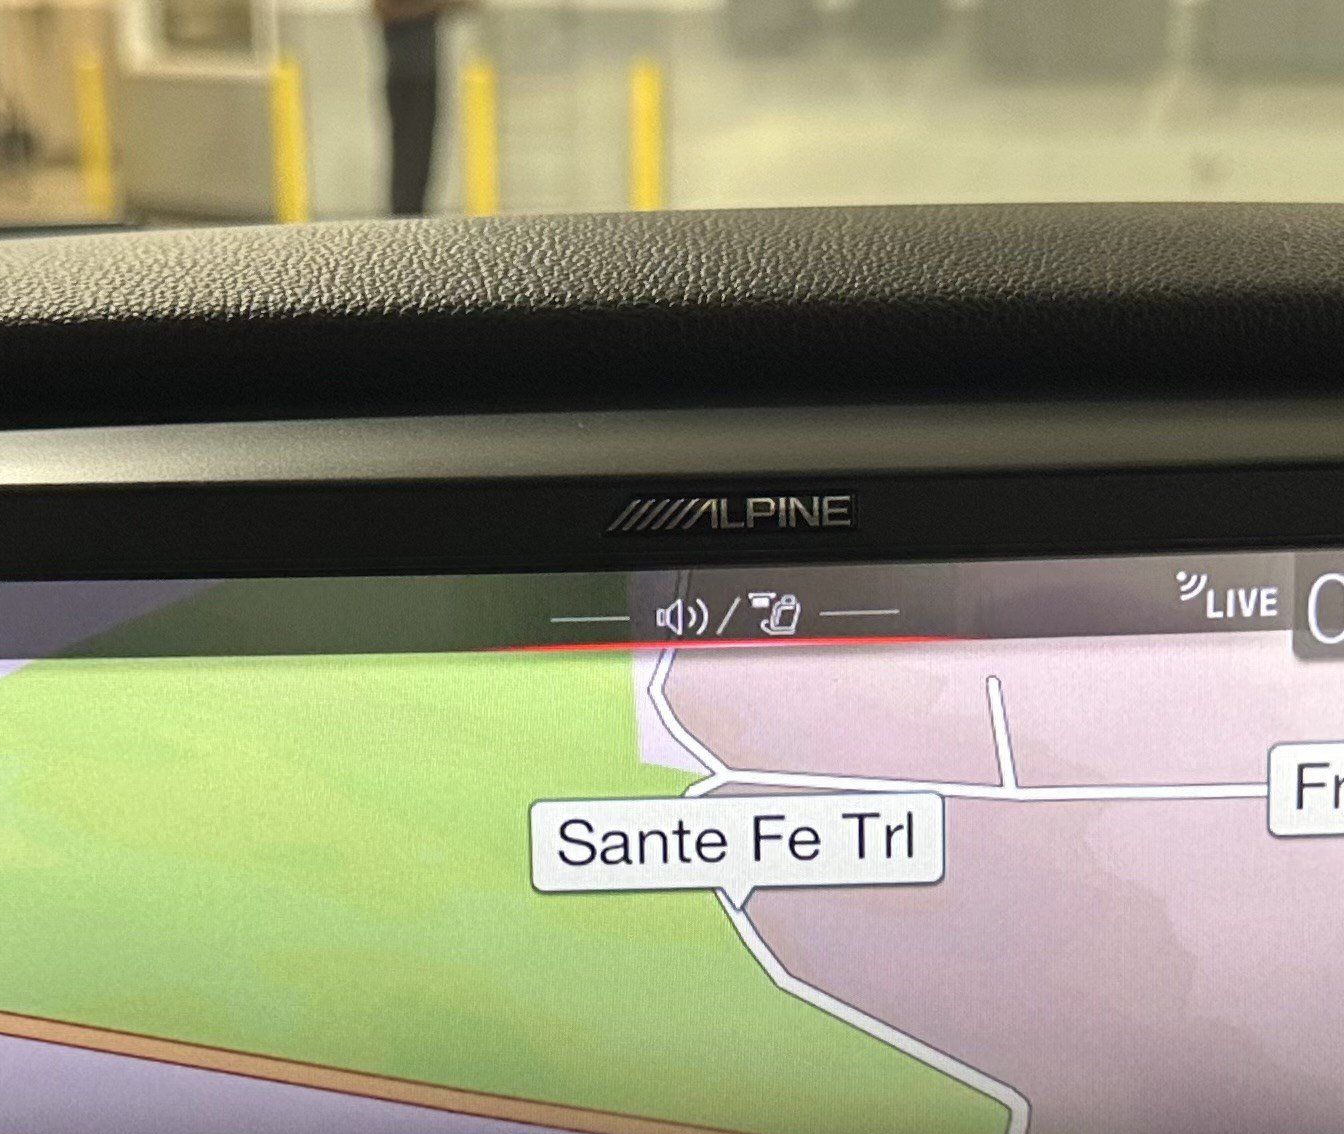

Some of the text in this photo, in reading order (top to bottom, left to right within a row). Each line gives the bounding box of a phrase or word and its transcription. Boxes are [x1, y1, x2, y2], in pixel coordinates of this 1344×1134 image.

[682, 494, 852, 531] ALPINE
[1205, 586, 1279, 620] LIVE
[557, 810, 915, 867] Sante Fe Trl
